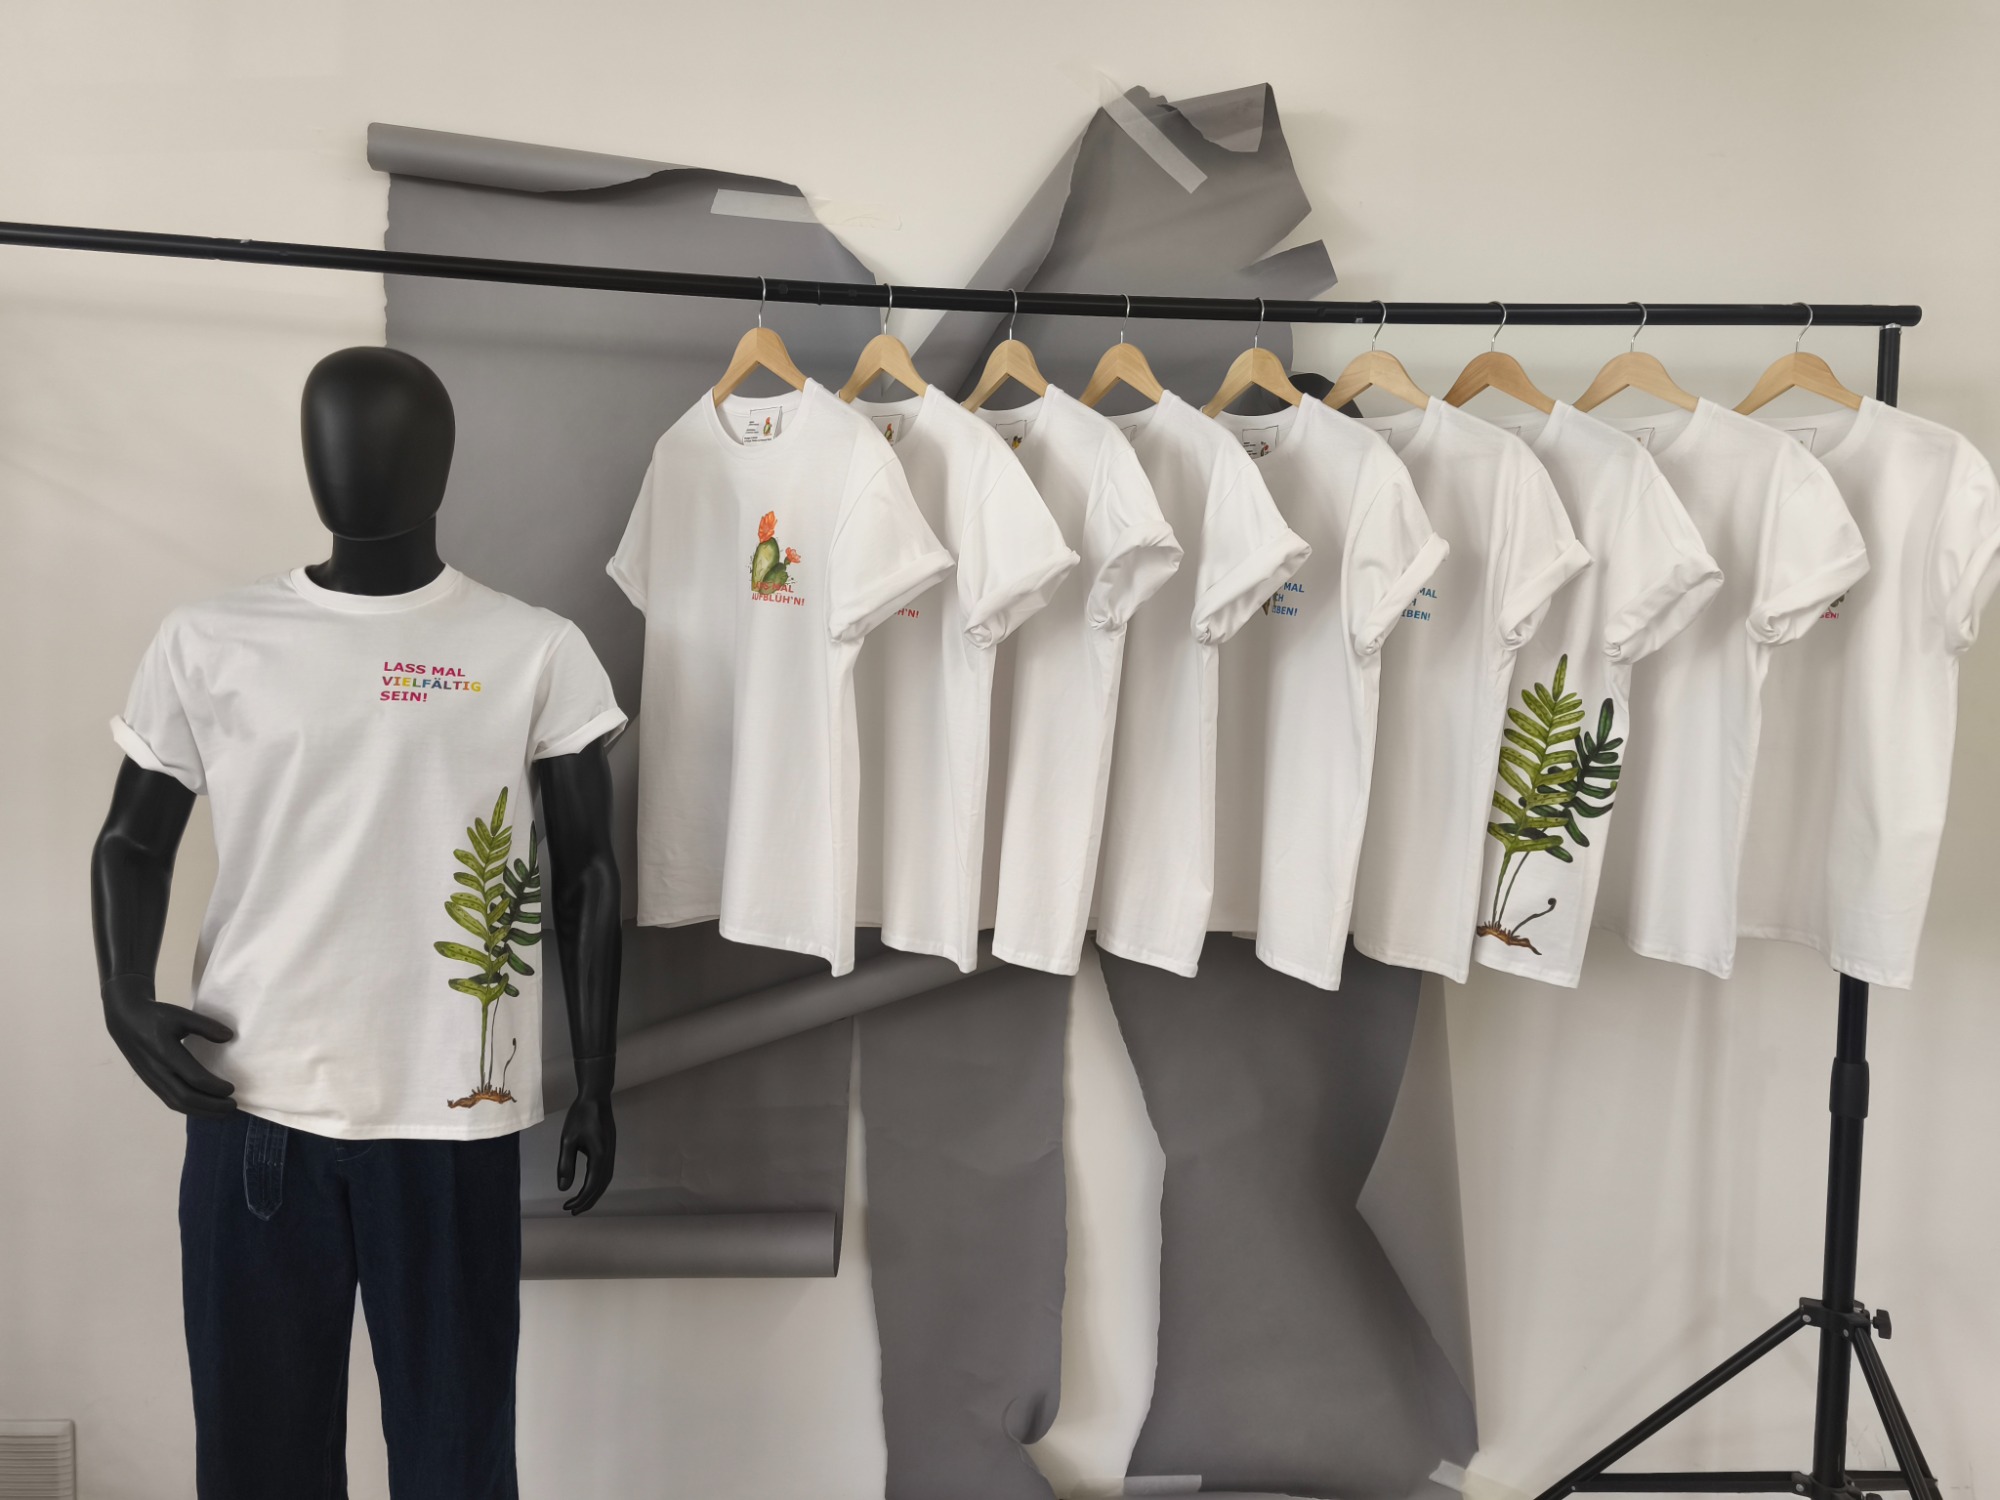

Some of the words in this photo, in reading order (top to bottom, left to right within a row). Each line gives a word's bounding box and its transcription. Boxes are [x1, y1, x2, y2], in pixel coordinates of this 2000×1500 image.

[1283, 582, 1305, 593] MAL
[383, 661, 426, 675] LASS
[431, 666, 466, 677] MAL
[382, 676, 482, 692] VIELFÄLTIG
[380, 690, 428, 702] SEIN!
